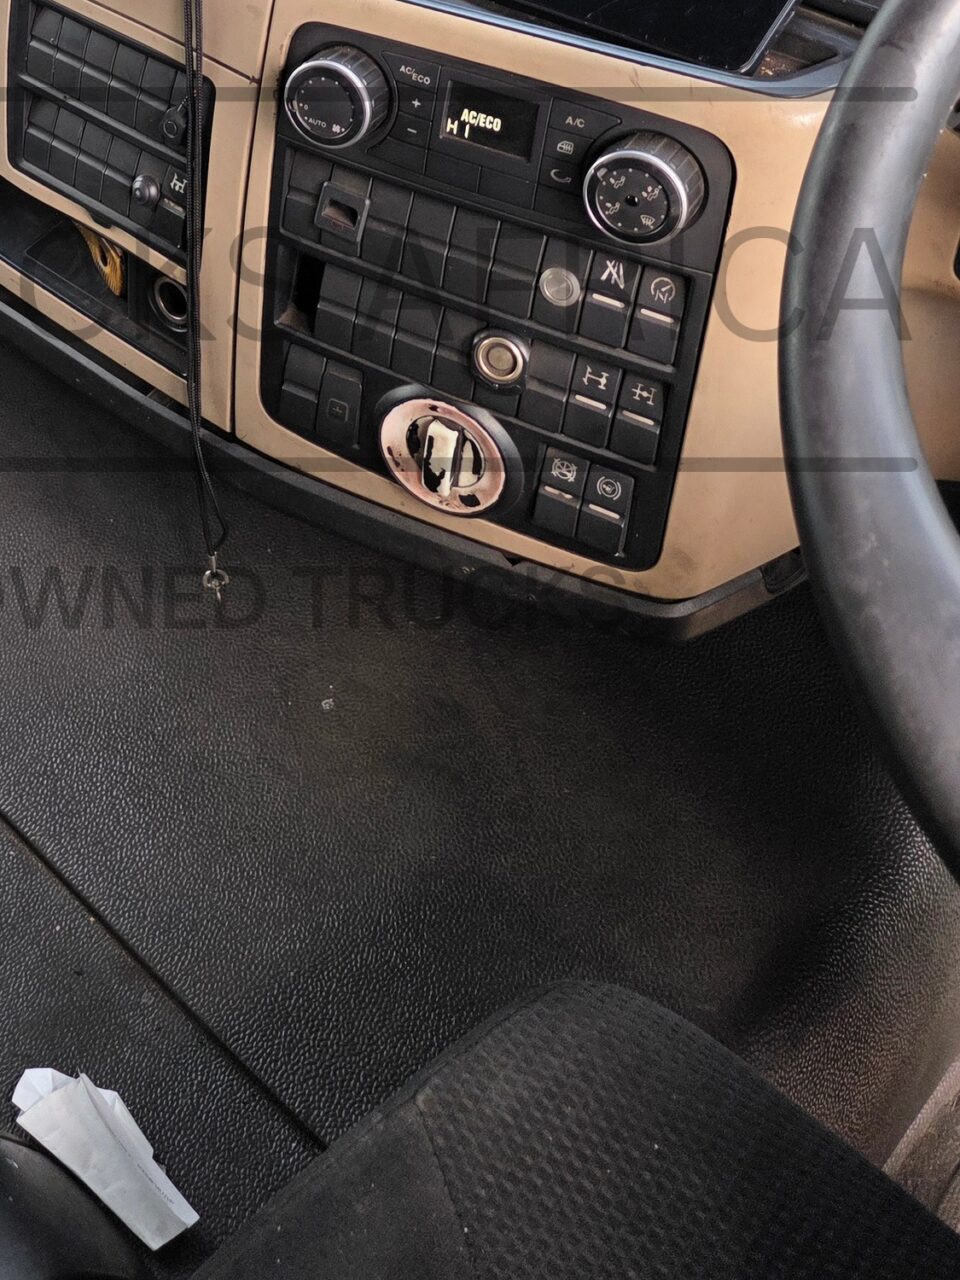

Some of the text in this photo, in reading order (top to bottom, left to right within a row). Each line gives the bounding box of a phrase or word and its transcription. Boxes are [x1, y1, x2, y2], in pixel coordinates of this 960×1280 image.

[308, 117, 327, 128] AUTO
[460, 108, 502, 132] AC/ECO
[565, 115, 585, 128] A/C
